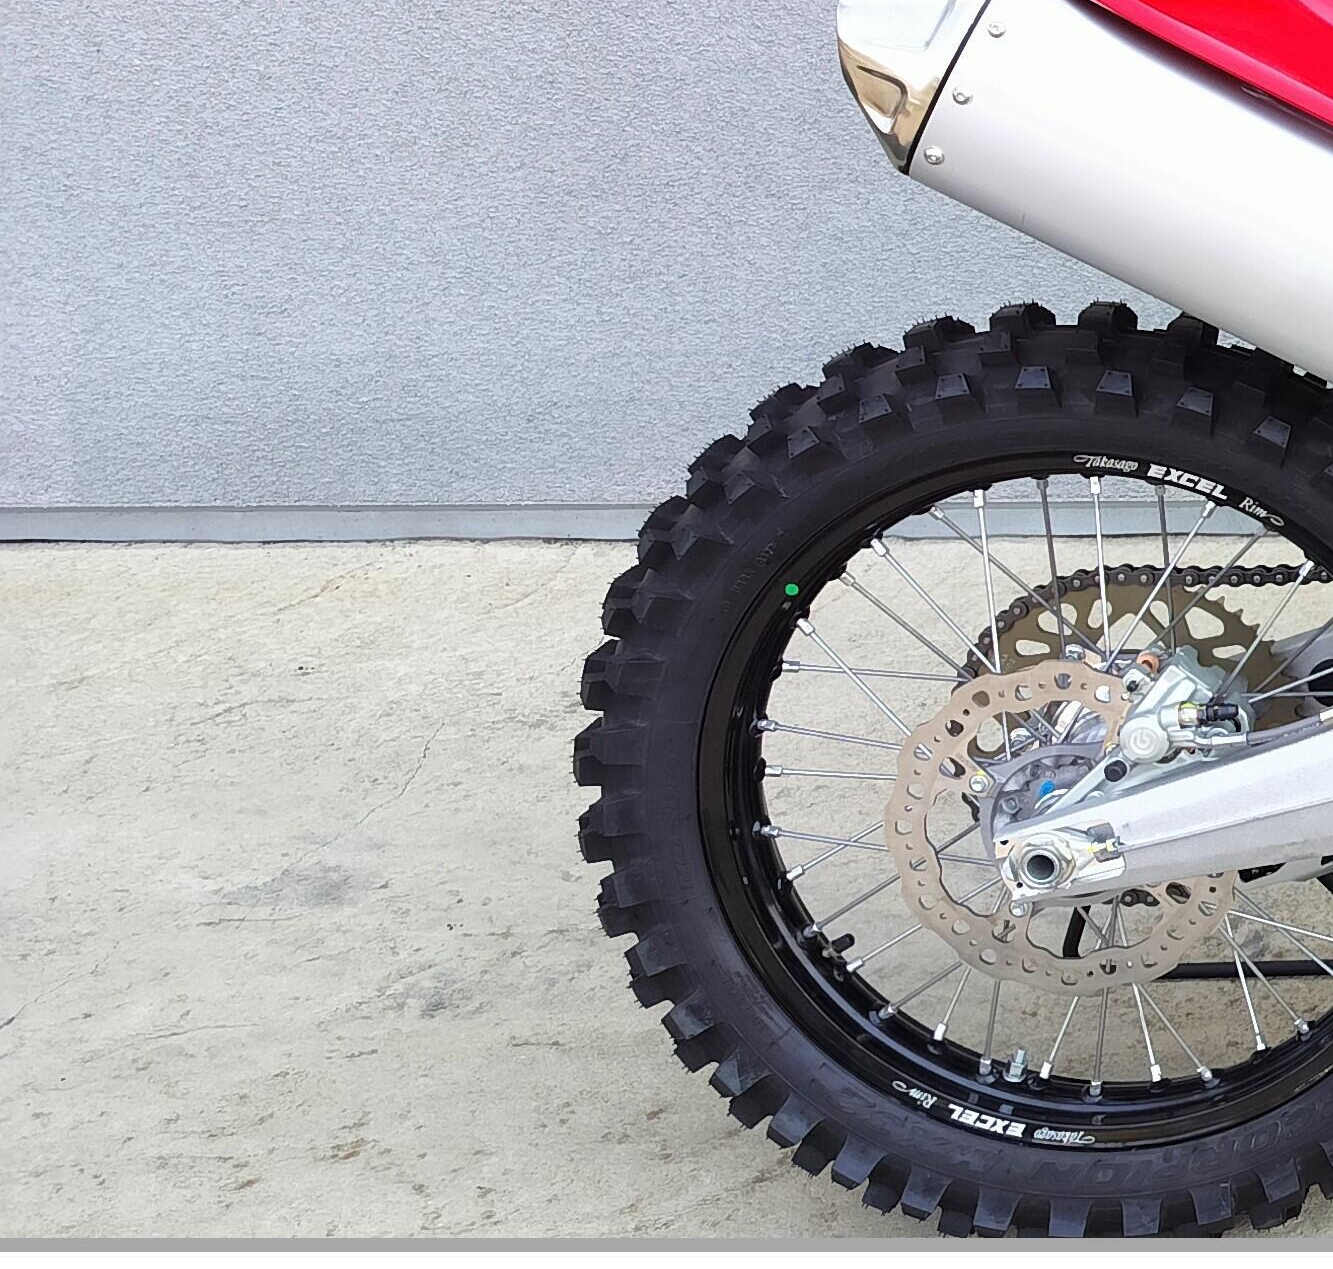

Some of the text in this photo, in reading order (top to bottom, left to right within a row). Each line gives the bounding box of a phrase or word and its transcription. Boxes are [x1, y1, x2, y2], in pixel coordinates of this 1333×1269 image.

[1073, 453, 1285, 527] Takasago EXCEL Rim
[891, 1080, 938, 1110] Rim
[948, 1102, 1026, 1138] EXCEL
